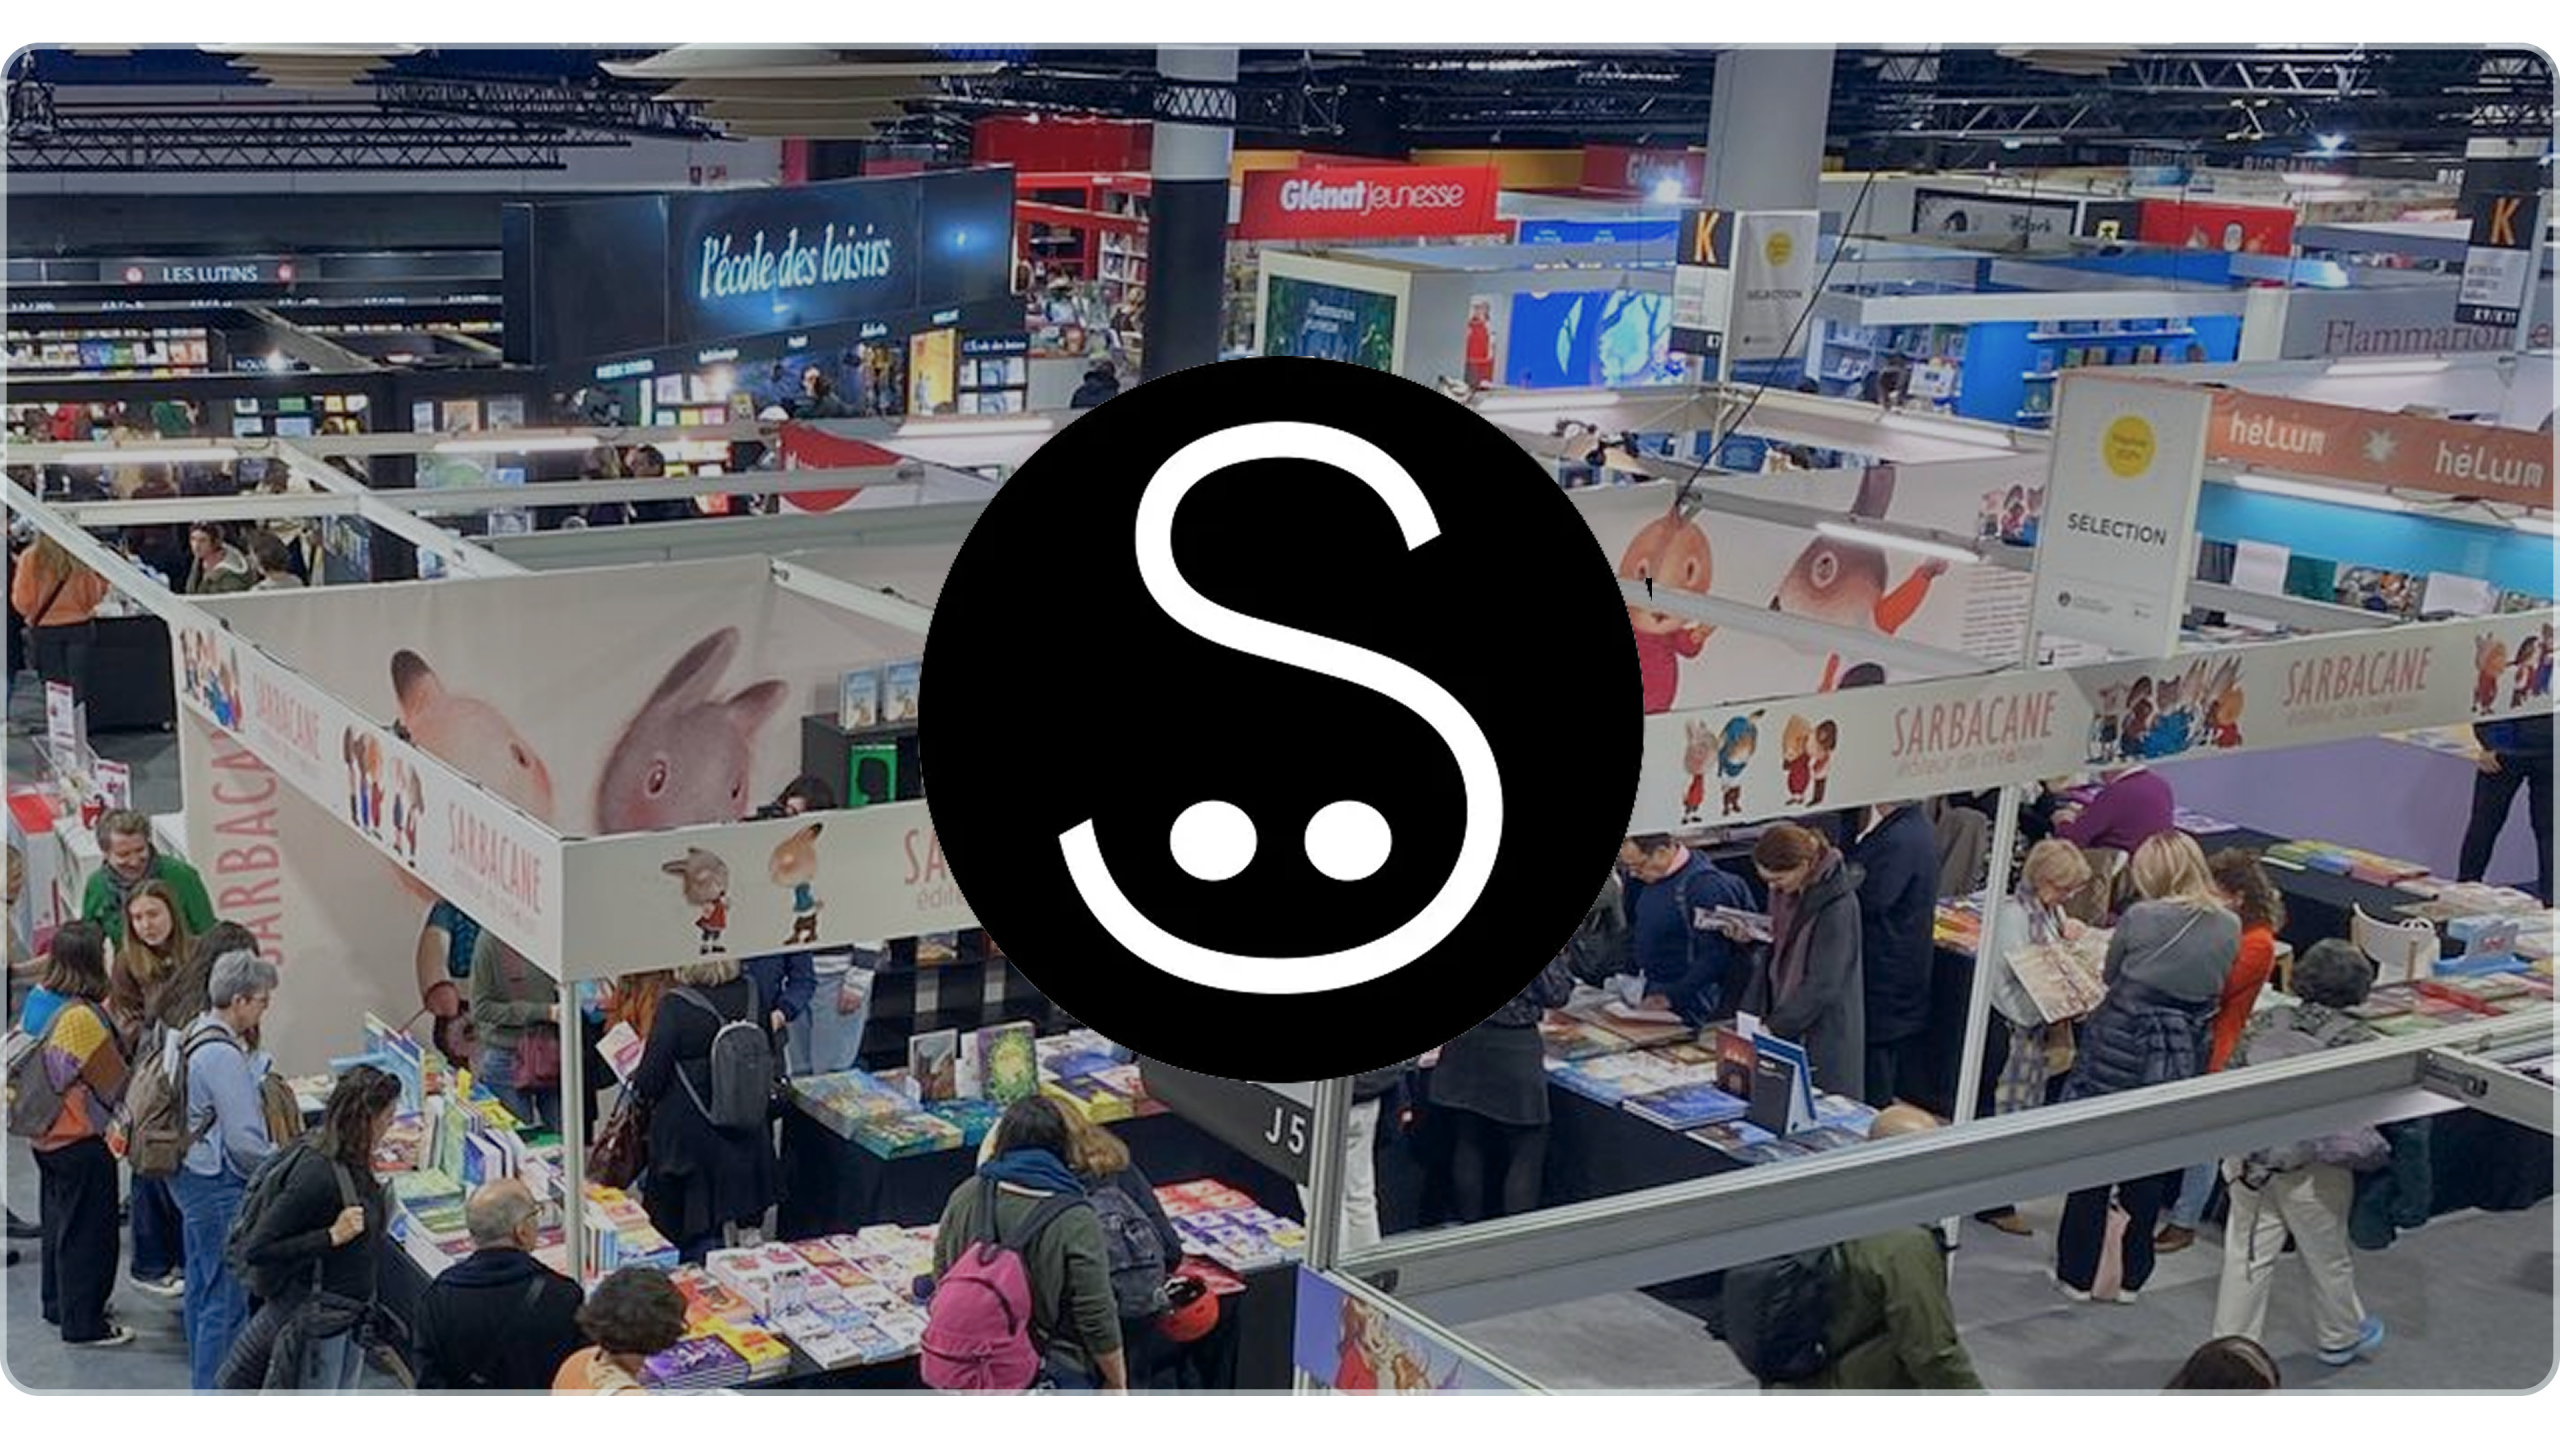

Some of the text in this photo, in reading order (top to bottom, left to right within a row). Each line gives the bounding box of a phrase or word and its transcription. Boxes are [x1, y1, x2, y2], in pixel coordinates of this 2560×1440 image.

[1281, 179, 1464, 216] Glénat jeunesse
[2491, 198, 2521, 247] K
[700, 221, 892, 299] l'école des loisirs
[1694, 211, 1719, 264] K
[163, 264, 258, 283] LES LUTINS
[2324, 319, 2514, 354] Flammarion
[2283, 646, 2433, 707] SARBACANE
[1892, 690, 2058, 757] SARBACANE
[447, 801, 542, 915] SARBACANE
